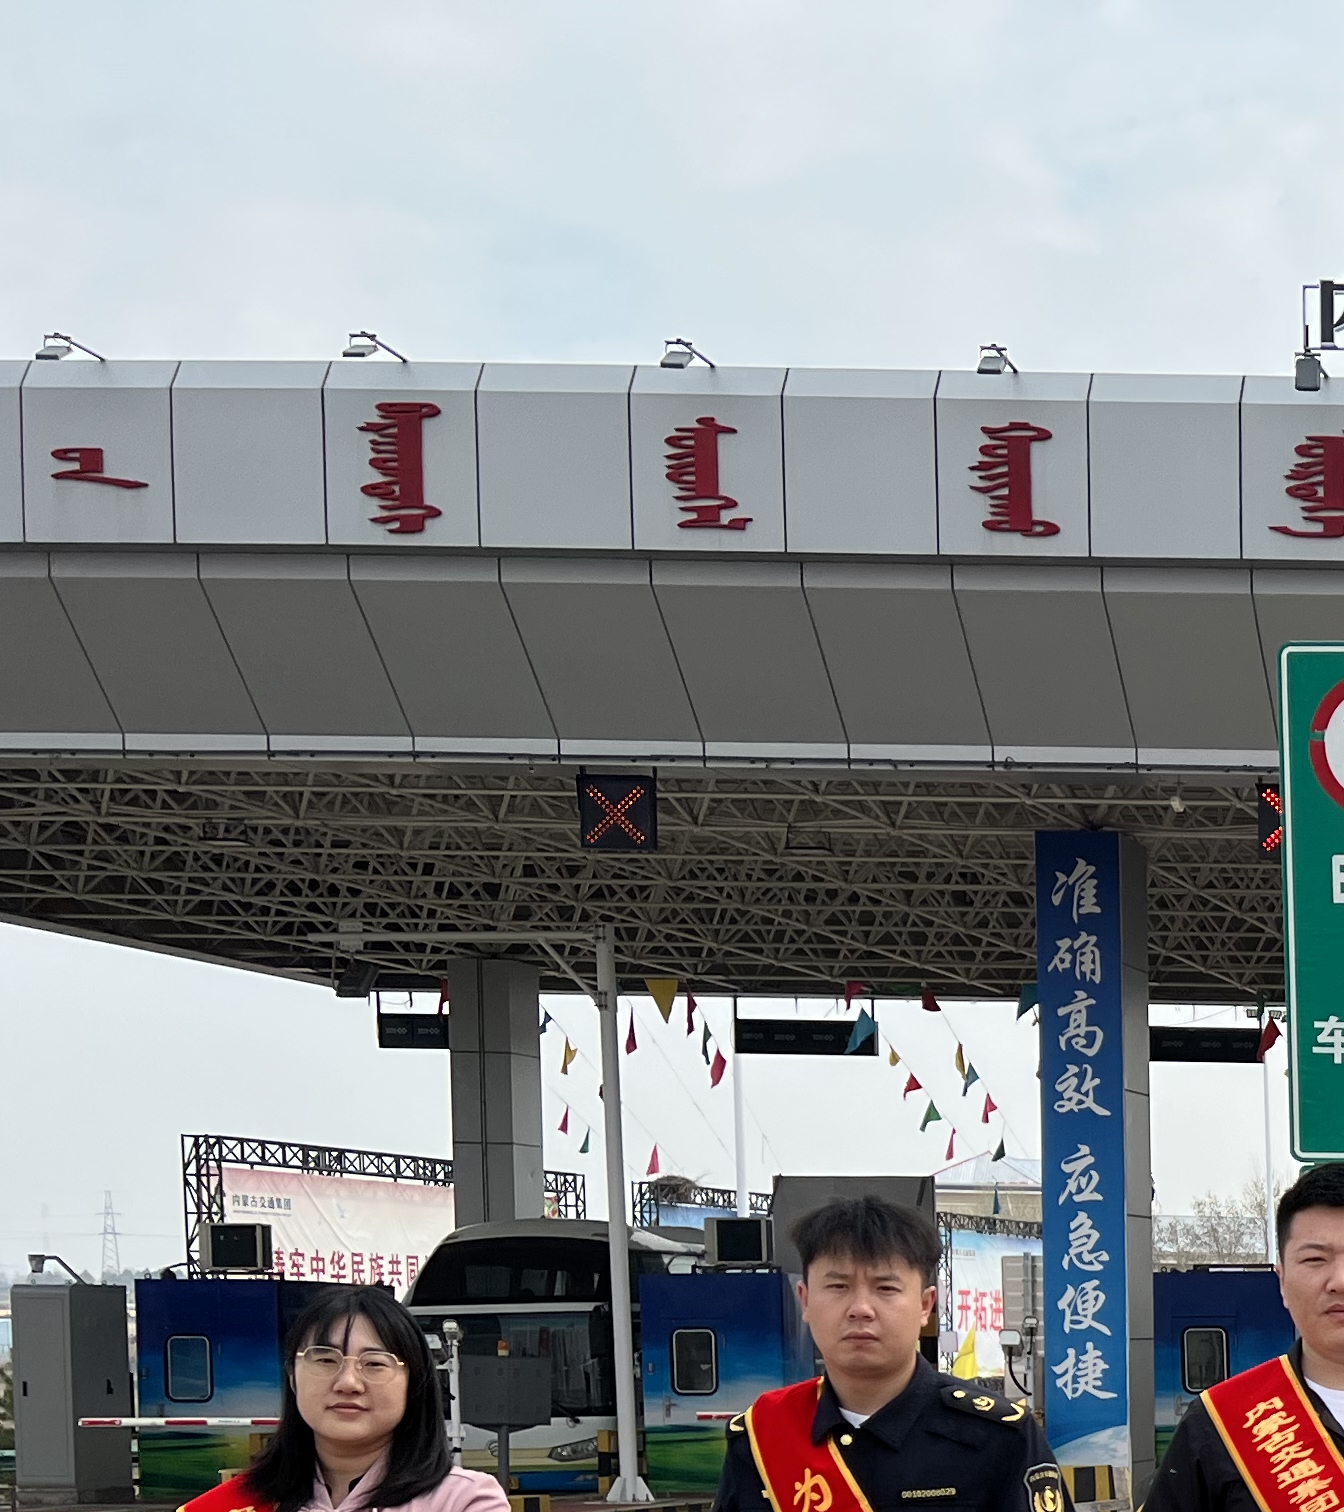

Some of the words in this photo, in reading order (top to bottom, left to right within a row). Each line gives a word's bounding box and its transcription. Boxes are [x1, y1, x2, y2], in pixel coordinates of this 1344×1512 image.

[1047, 857, 1111, 1116] 准确高效
[232, 1194, 291, 1210] 内蒙古交通集团
[1050, 1142, 1118, 1400] 应急便捷
